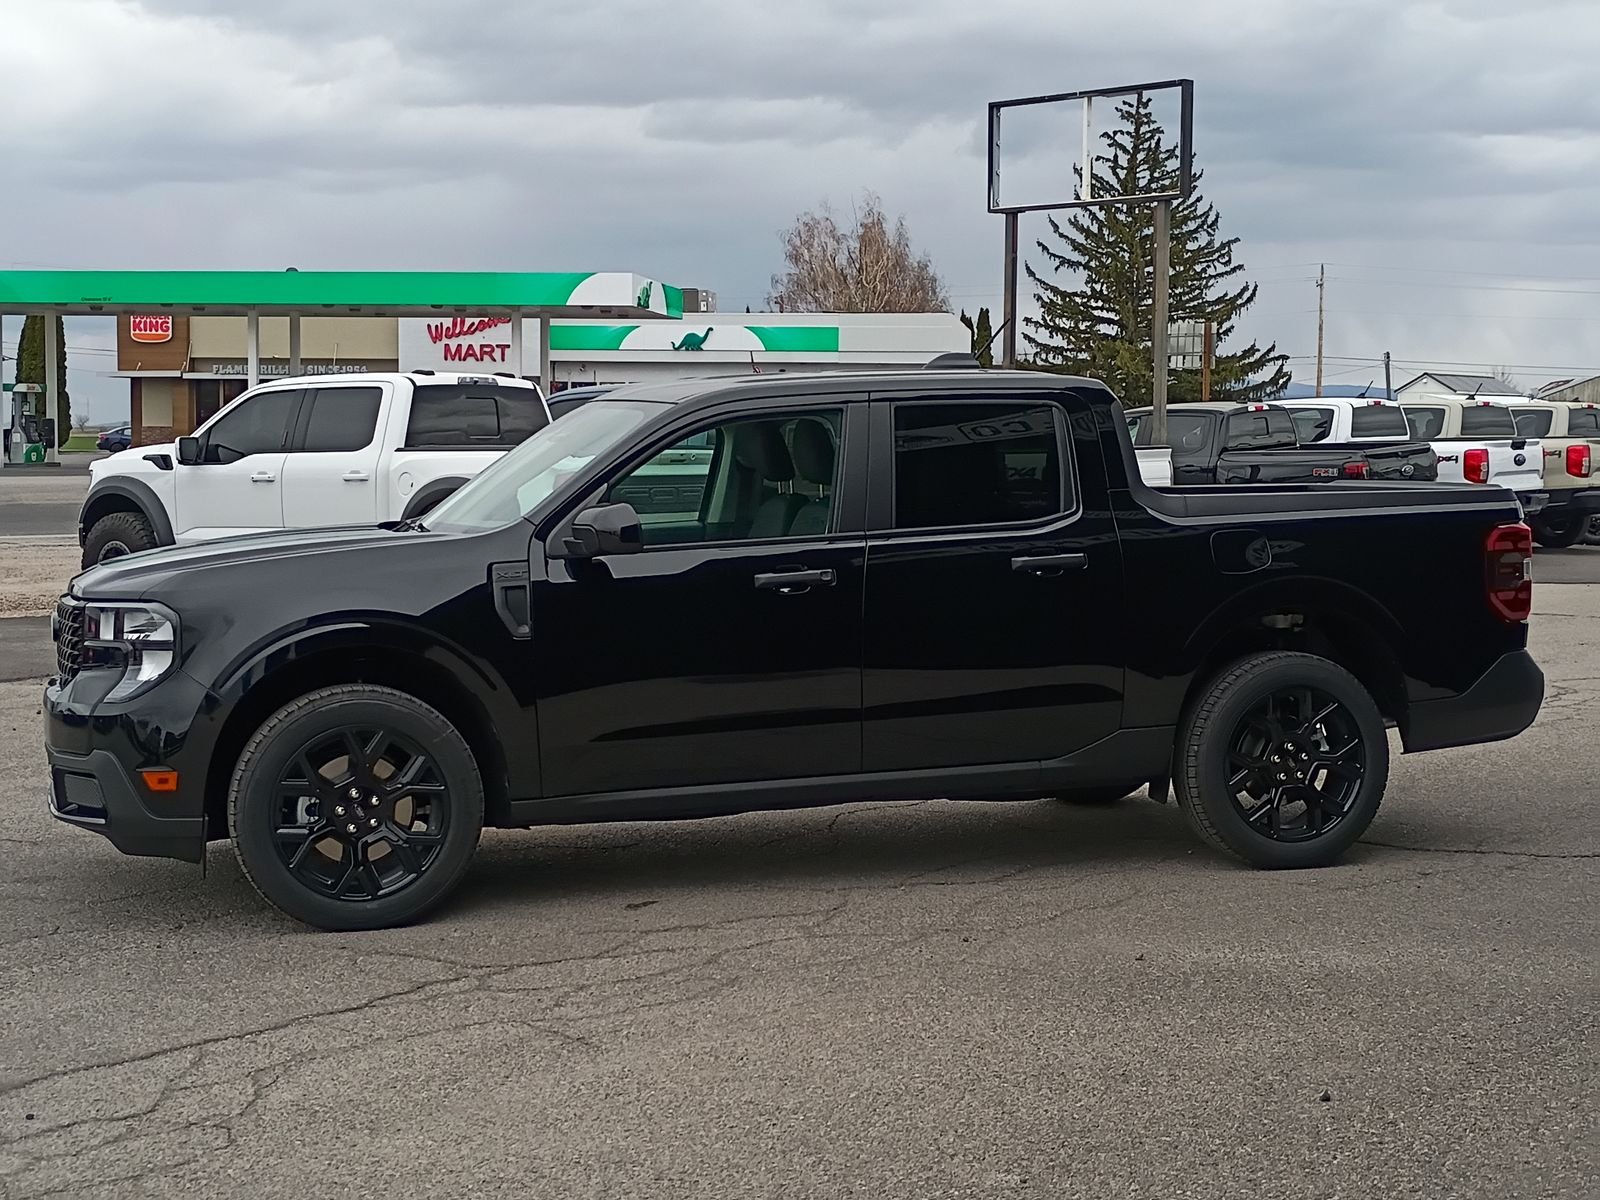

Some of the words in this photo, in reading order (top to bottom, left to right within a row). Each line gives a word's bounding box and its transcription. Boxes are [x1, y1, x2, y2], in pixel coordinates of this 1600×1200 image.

[132, 320, 170, 332] KING
[444, 343, 510, 362] MART
[306, 364, 341, 375] SINCE
